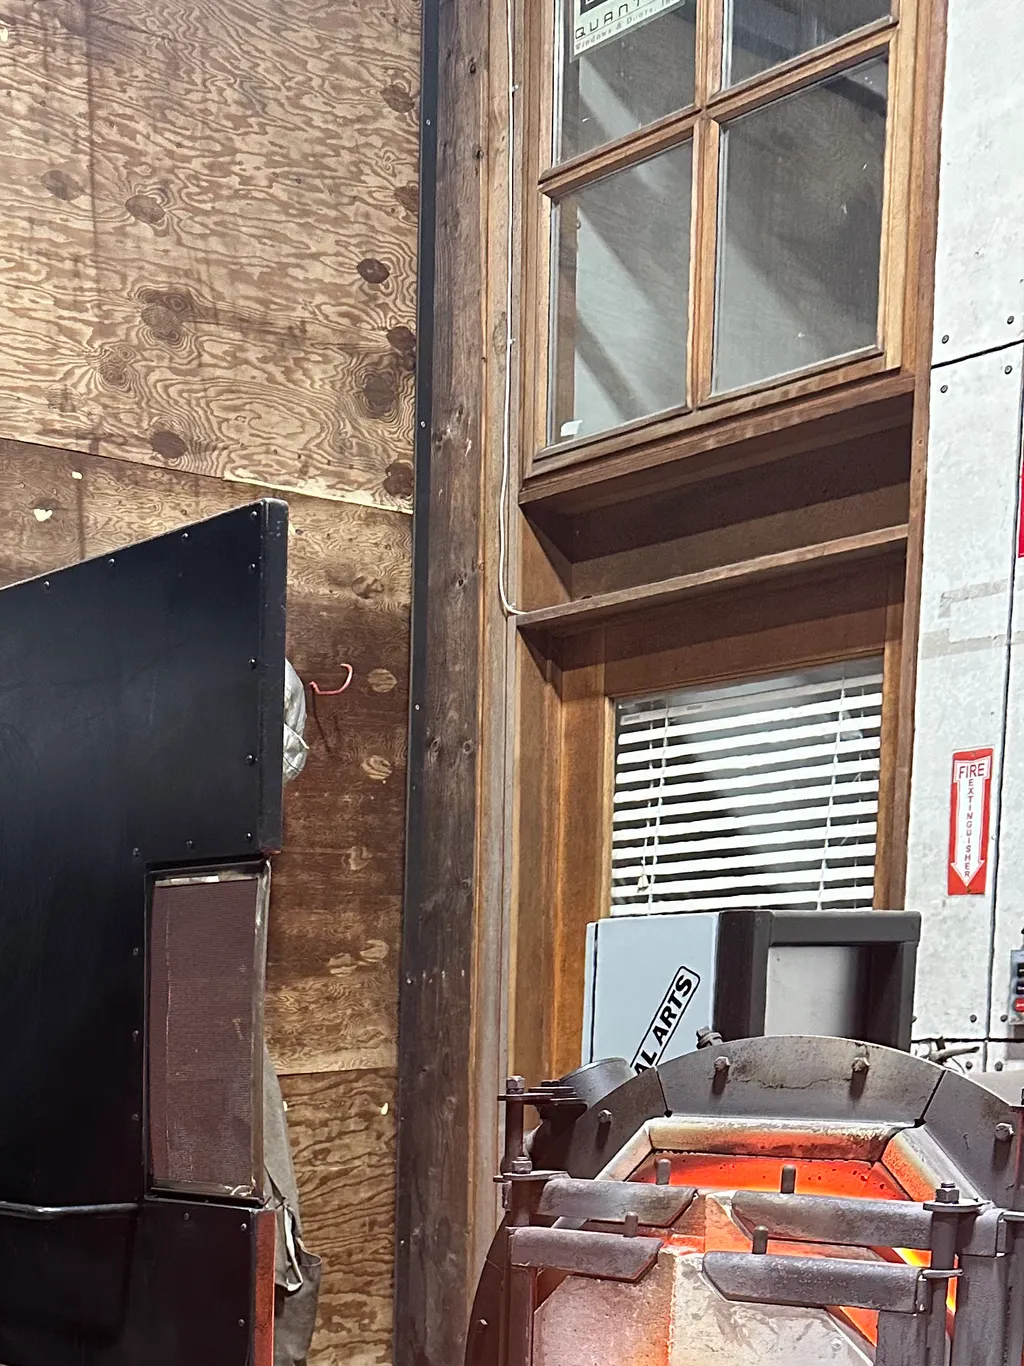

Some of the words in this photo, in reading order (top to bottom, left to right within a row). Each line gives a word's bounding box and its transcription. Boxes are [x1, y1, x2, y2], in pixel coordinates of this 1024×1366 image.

[958, 763, 985, 779] FIRE
[964, 778, 974, 878] EXTINGUISHER
[652, 974, 693, 1047] ARTS
